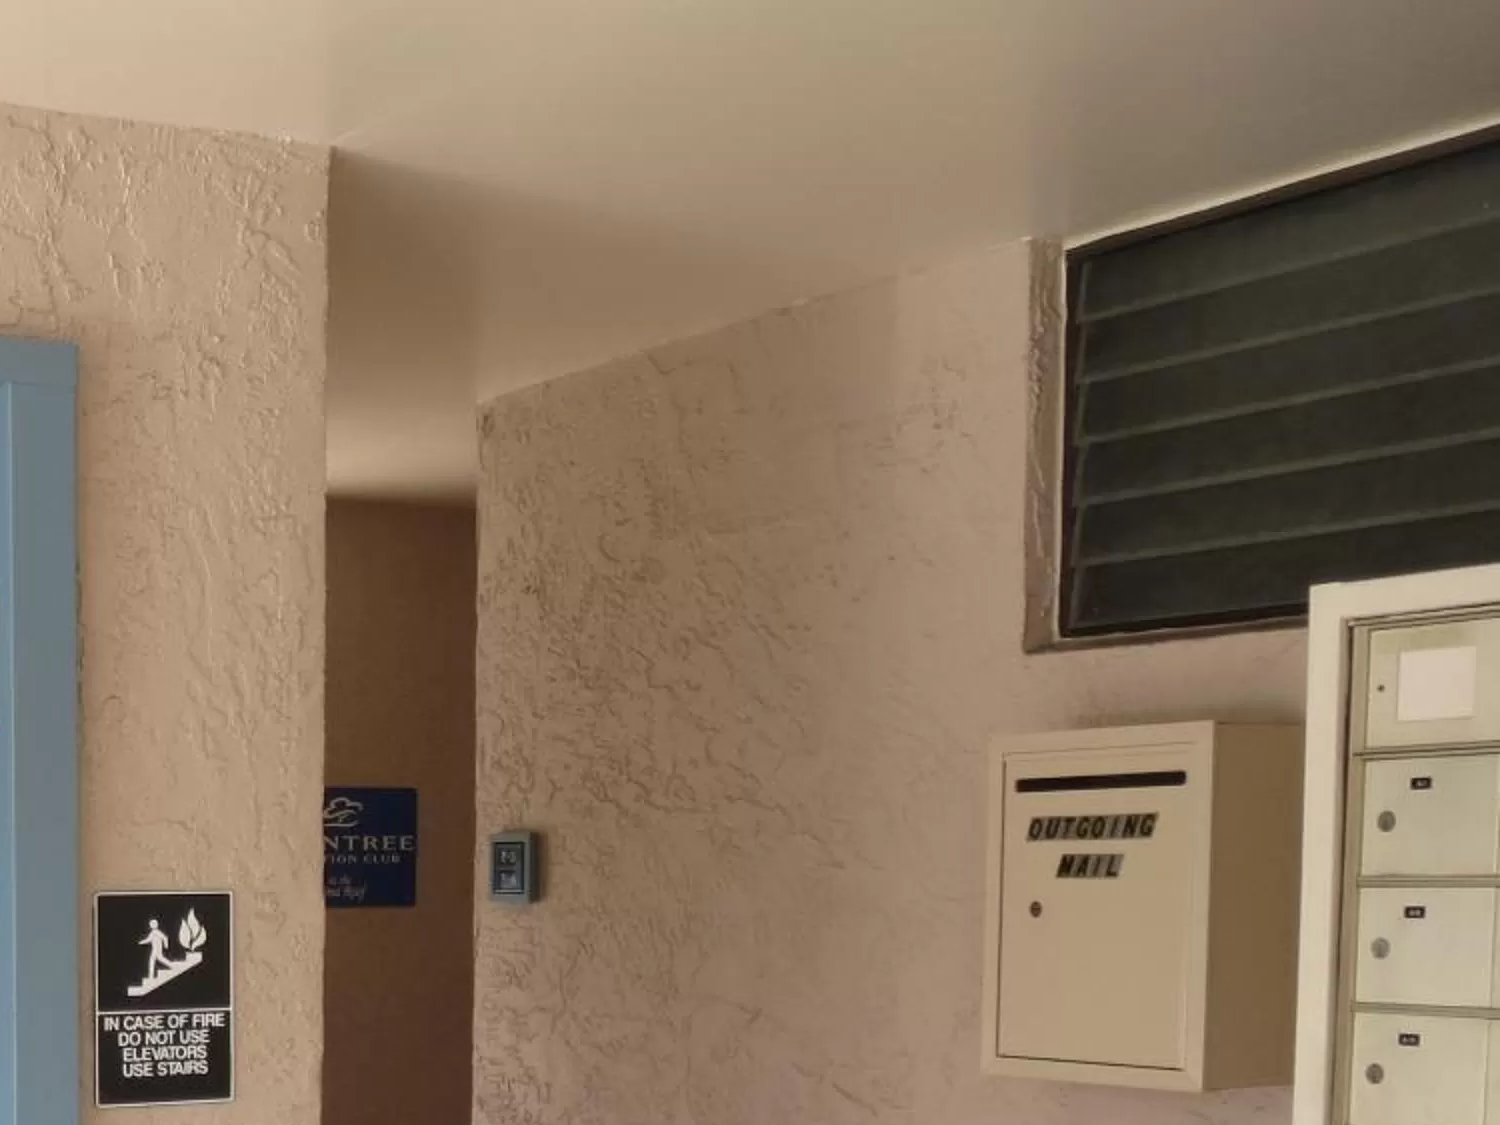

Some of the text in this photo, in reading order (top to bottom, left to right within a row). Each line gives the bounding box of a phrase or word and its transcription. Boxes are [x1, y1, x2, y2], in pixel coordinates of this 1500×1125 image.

[1028, 813, 1157, 840] OUTGOING
[324, 835, 414, 851] NTREE
[1057, 855, 1118, 877] MAIL
[104, 1012, 226, 1031] IN CASE OF FIRE
[118, 1029, 211, 1047] DO NOT USE
[123, 1045, 208, 1062] ELEVATORS
[123, 1060, 209, 1078] USE STAIRS
